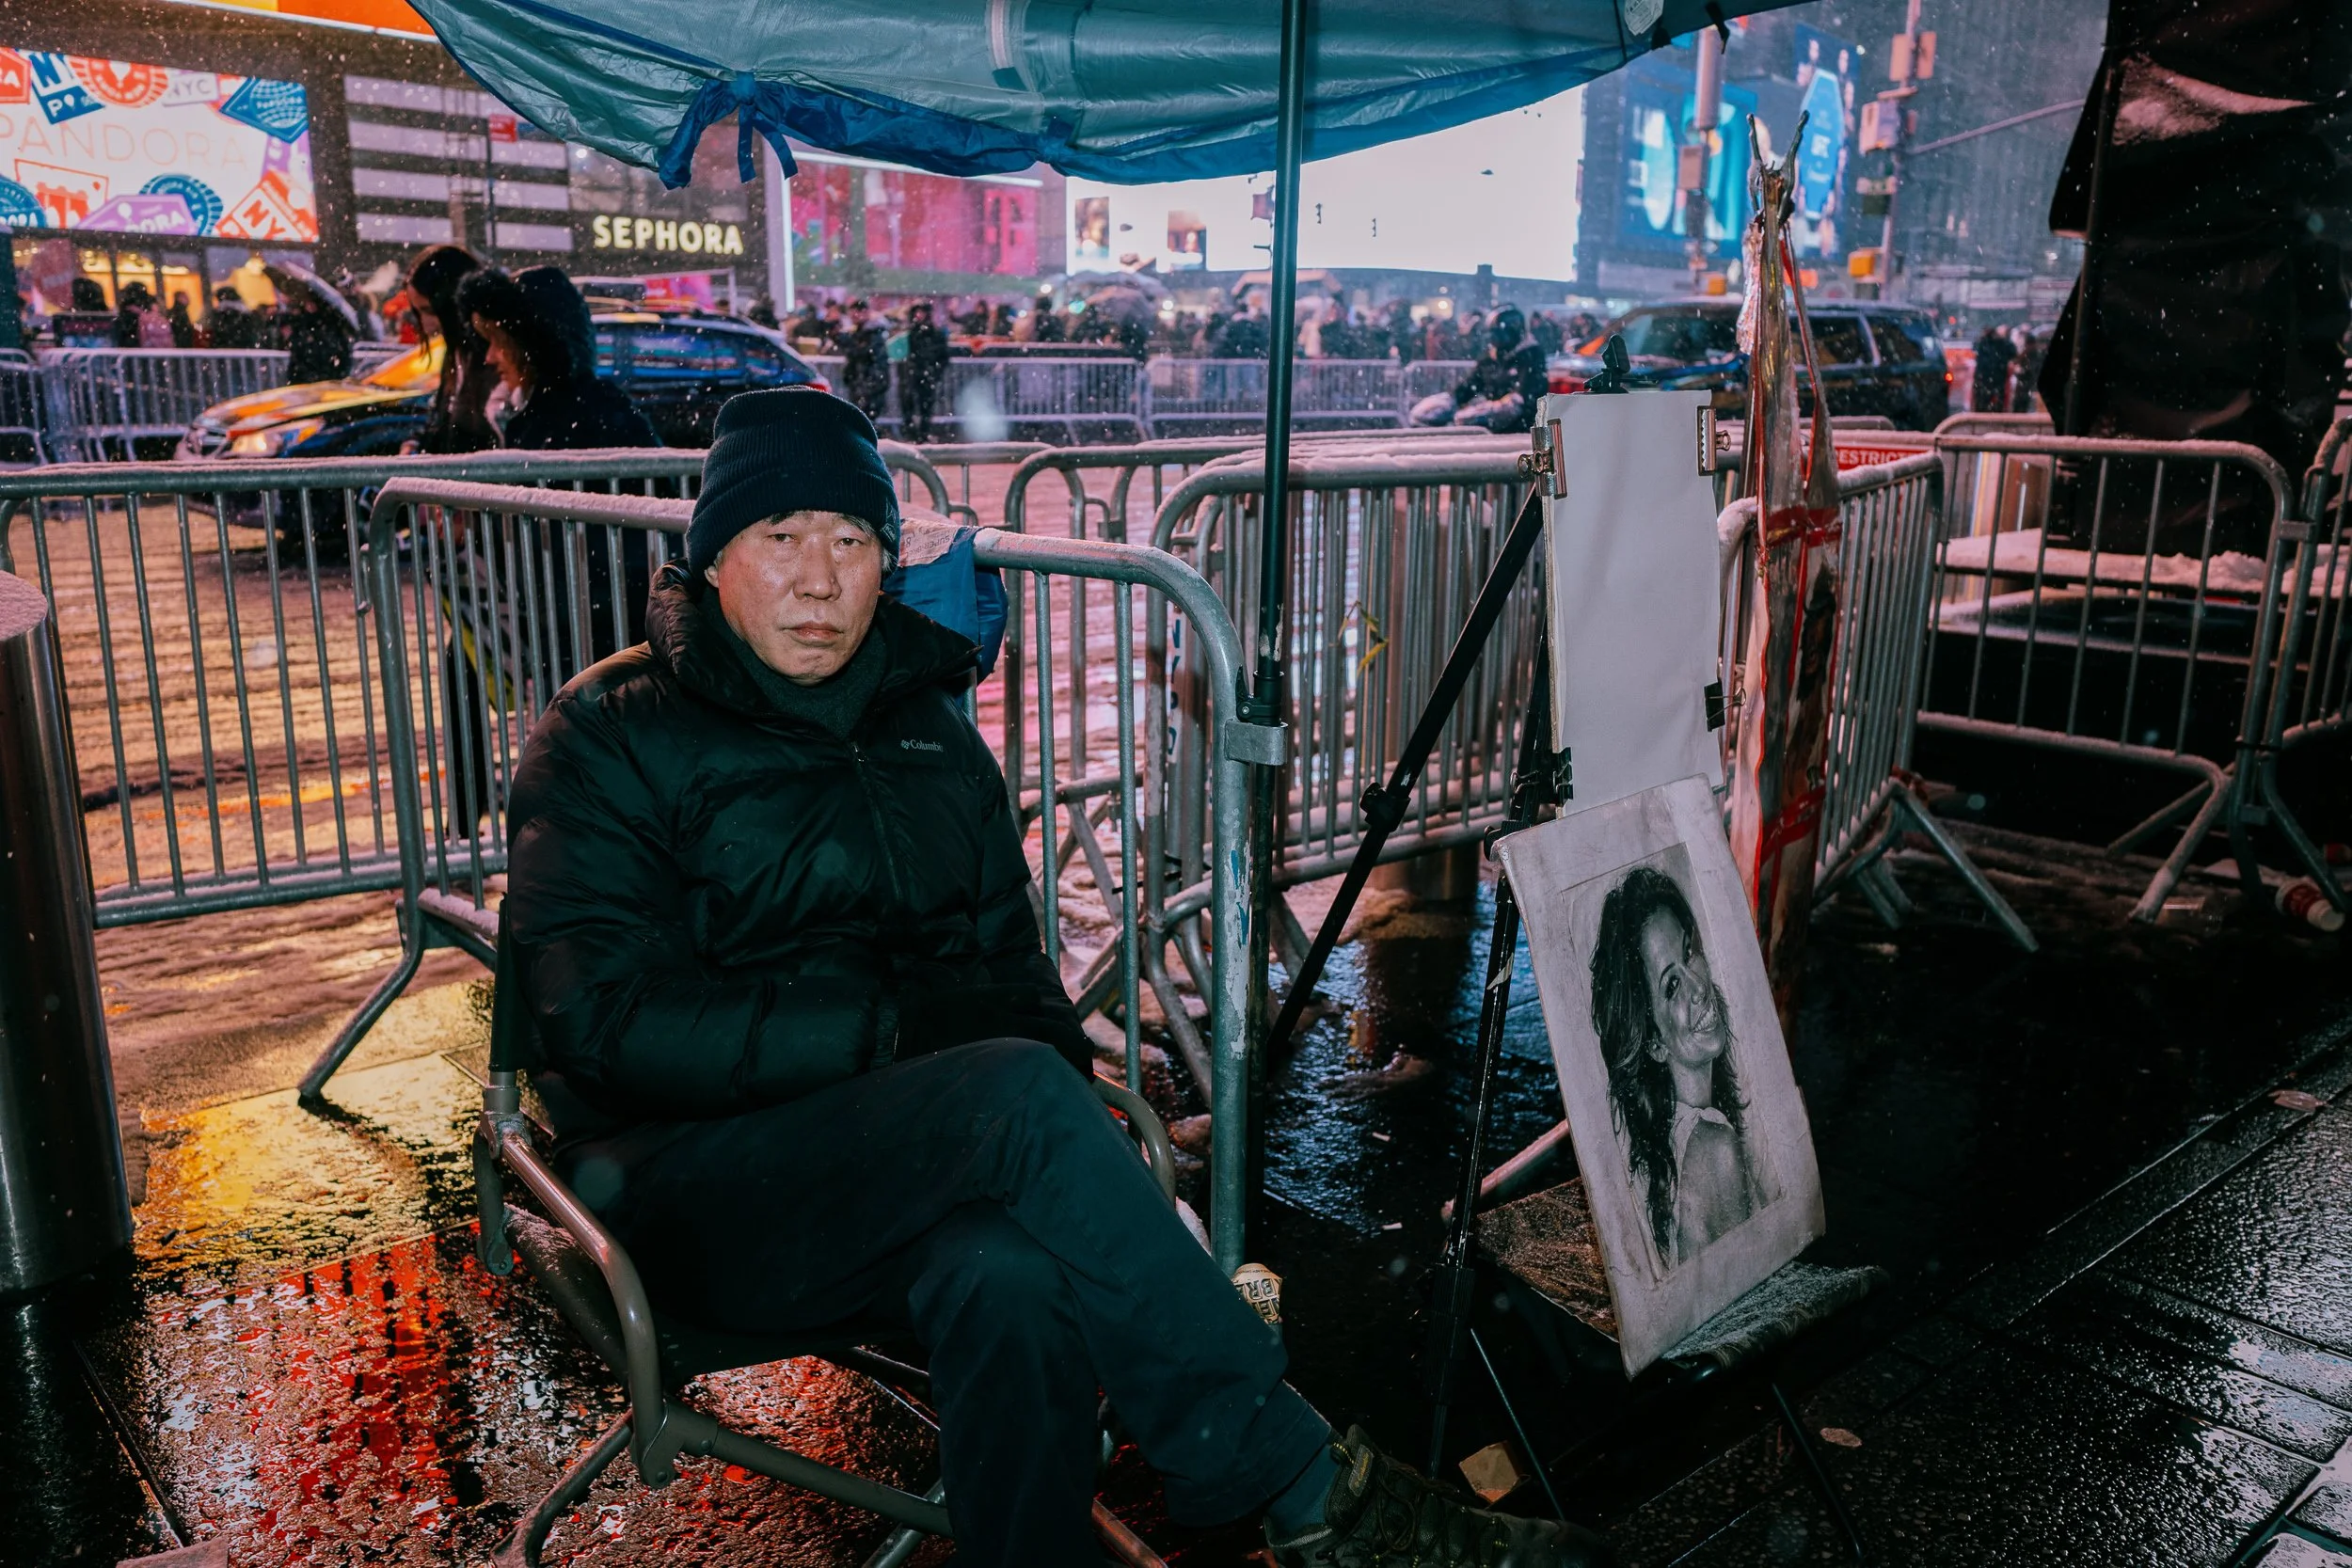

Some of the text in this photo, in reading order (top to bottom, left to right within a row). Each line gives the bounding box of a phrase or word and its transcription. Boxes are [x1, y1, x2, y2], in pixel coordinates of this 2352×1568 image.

[167, 79, 211, 100] NYC
[243, 198, 292, 241] NY
[593, 214, 744, 256] SEPHORA
